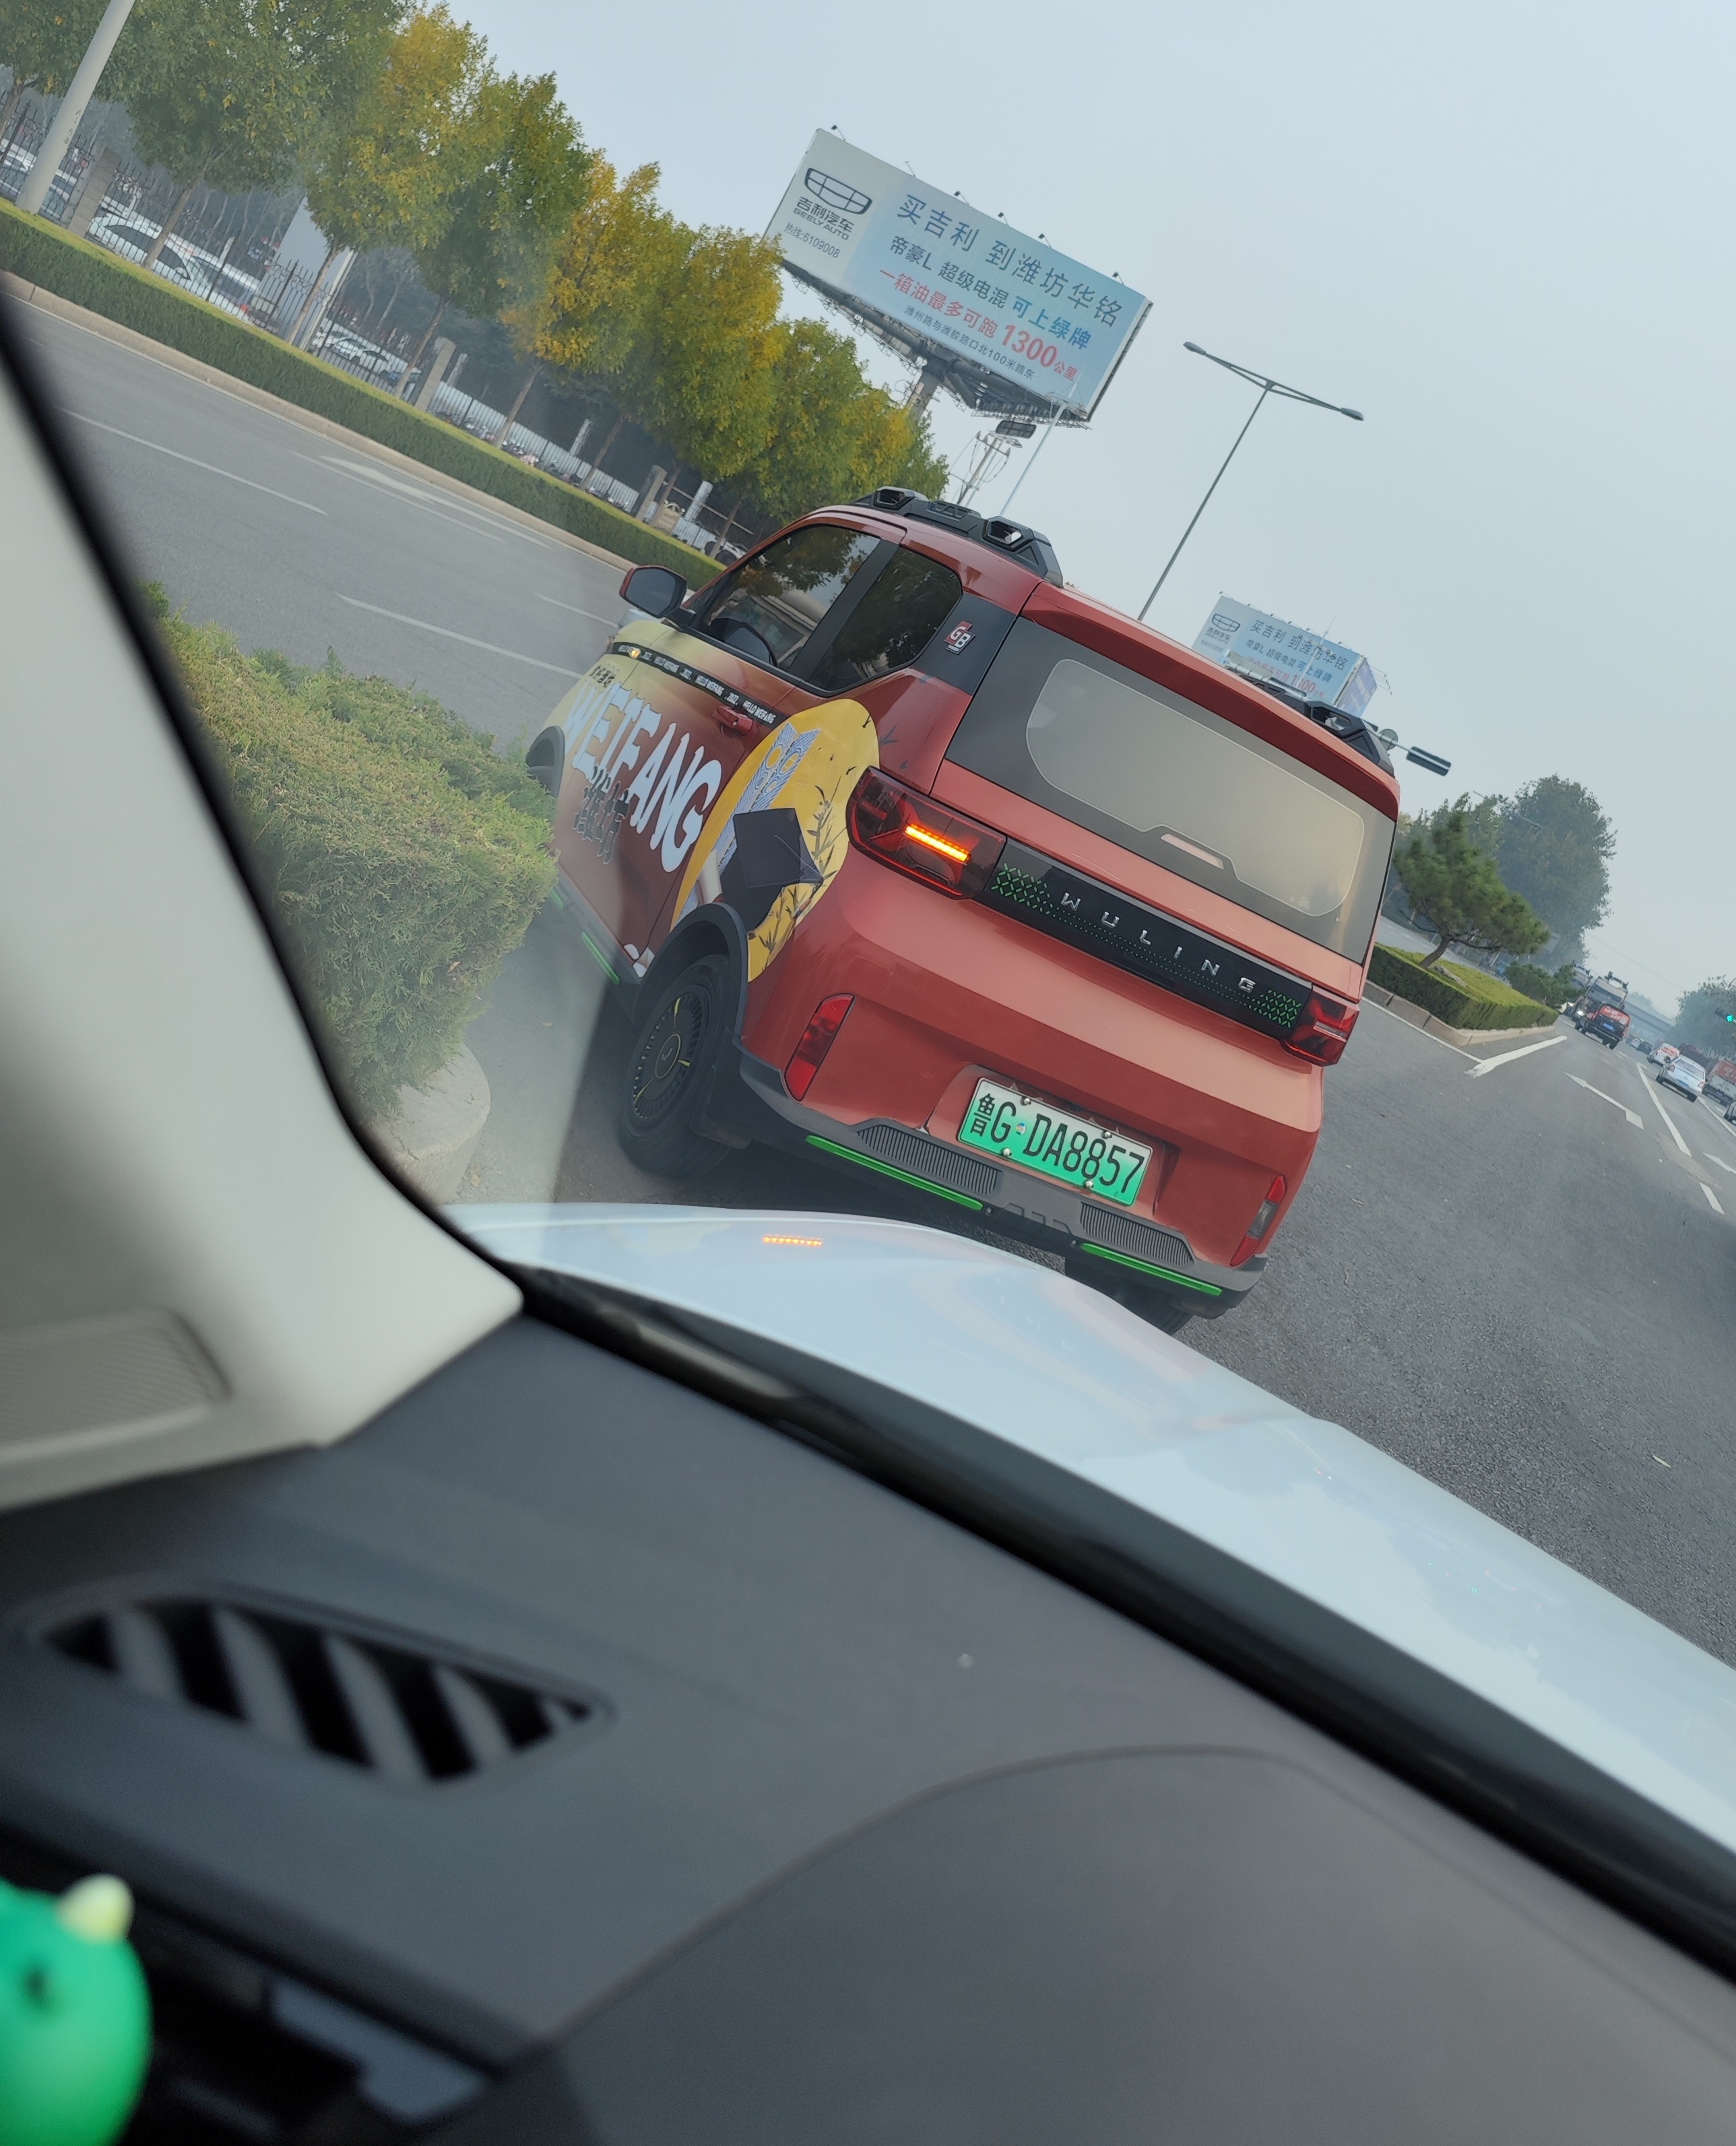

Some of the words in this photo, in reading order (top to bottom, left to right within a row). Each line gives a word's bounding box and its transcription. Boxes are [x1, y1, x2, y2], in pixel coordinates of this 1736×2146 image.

[793, 208, 824, 226] GEELY
[823, 224, 849, 241] AUTO
[797, 196, 855, 232] 吉利汽车
[897, 194, 979, 252] 买吉利
[985, 240, 1122, 327] 到潍坊华铭
[890, 236, 932, 271] 帝豪L
[938, 261, 1009, 309] 超级电混
[1012, 295, 1092, 350] 可上绿牌
[1250, 620, 1287, 643] 买吉利
[563, 682, 722, 873] WEIFANG
[1060, 891, 1257, 993] WULING
